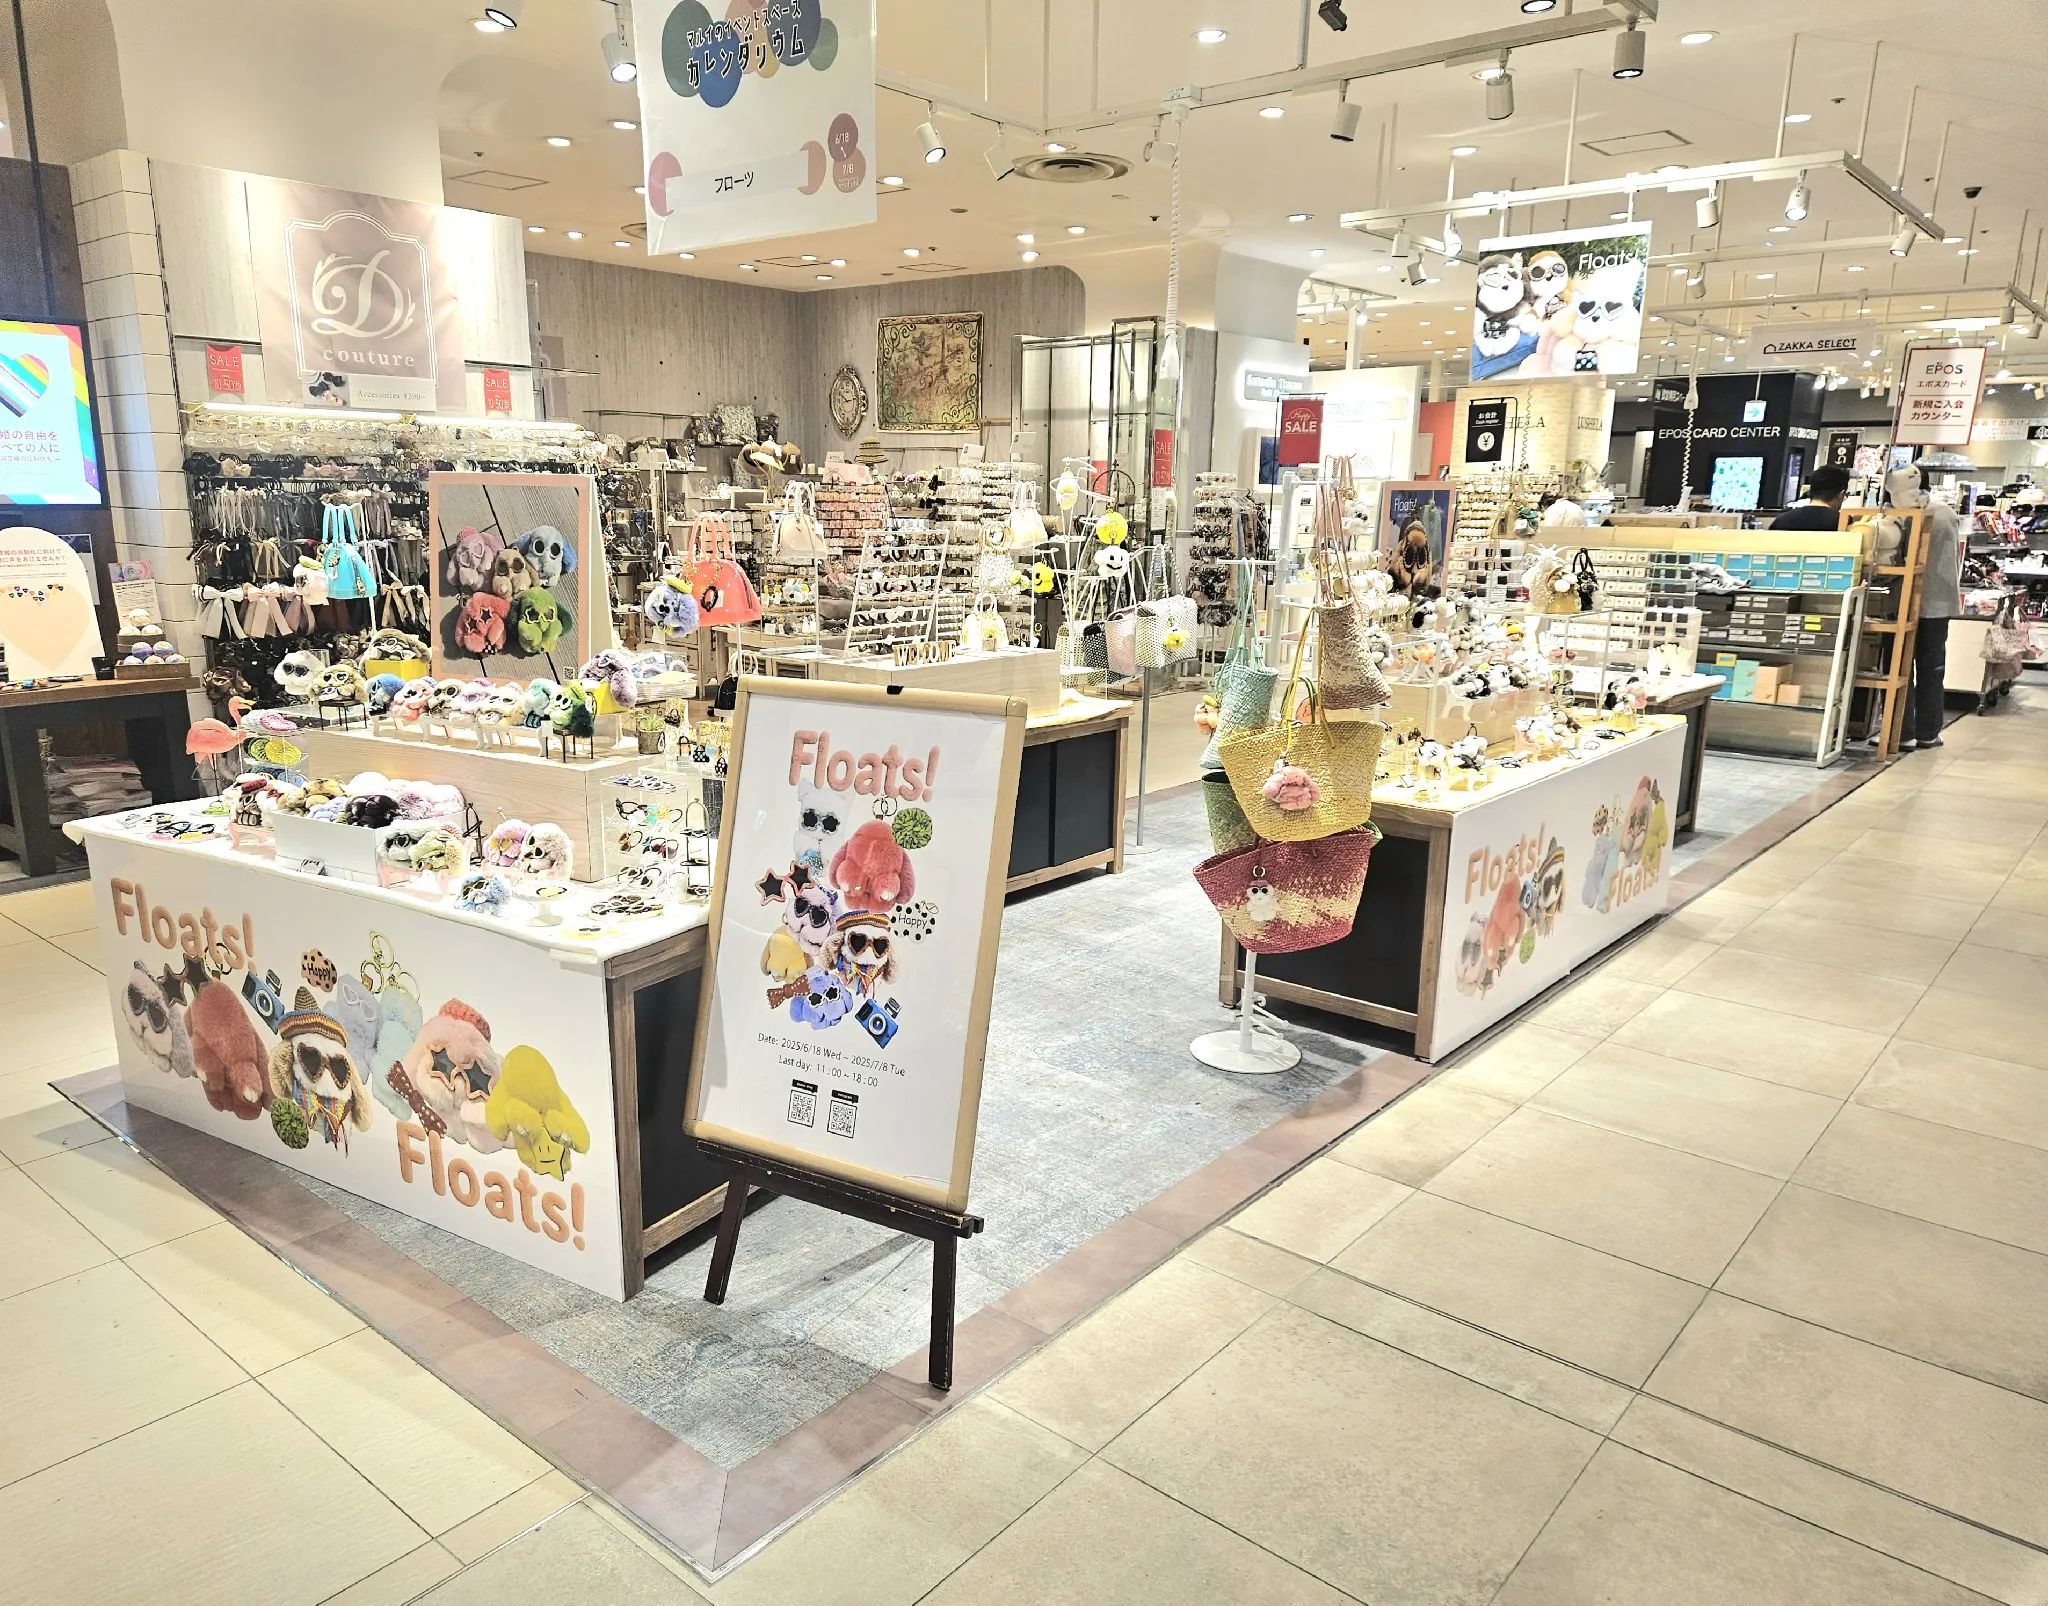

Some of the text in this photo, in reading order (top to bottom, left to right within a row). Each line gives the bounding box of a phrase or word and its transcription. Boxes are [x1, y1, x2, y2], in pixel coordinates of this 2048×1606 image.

[686, 0, 802, 49] マルイのイベントスペース
[686, 25, 806, 89] カレンダリウム
[835, 132, 850, 145] 6/18
[842, 163, 854, 176] 7/8
[714, 171, 754, 194] フローツ
[1778, 338, 1857, 351] ZAKKA SELECT
[210, 354, 240, 367] SALE
[323, 349, 416, 367] couture
[1925, 362, 1964, 375] EPOS
[485, 377, 507, 388] SALE
[1916, 380, 1968, 388] エポスカード
[358, 390, 400, 399] Accessories
[1912, 400, 1965, 409] 新規ご入会
[1910, 411, 1962, 421] カウンター
[1285, 421, 1317, 433] SALE
[1658, 428, 1692, 439] EPOS
[1692, 427, 1727, 438] CARD
[1730, 426, 1781, 438] CENTER
[1155, 441, 1172, 455] SALE
[789, 730, 940, 802] Floats!
[1465, 822, 1545, 904] Floats!
[1606, 852, 1662, 913] Floats!
[110, 877, 257, 975] Floats!
[898, 913, 928, 929] Happy
[307, 963, 330, 981] Happy
[758, 1033, 779, 1046] Date:
[781, 1038, 821, 1056] 2025/6/18
[823, 1048, 841, 1061] Wed
[851, 1055, 888, 1072] 2025/7/8
[890, 1064, 906, 1077] Tue
[778, 1055, 795, 1066] Last
[796, 1059, 812, 1072] day:
[396, 1120, 586, 1251] Floats!
